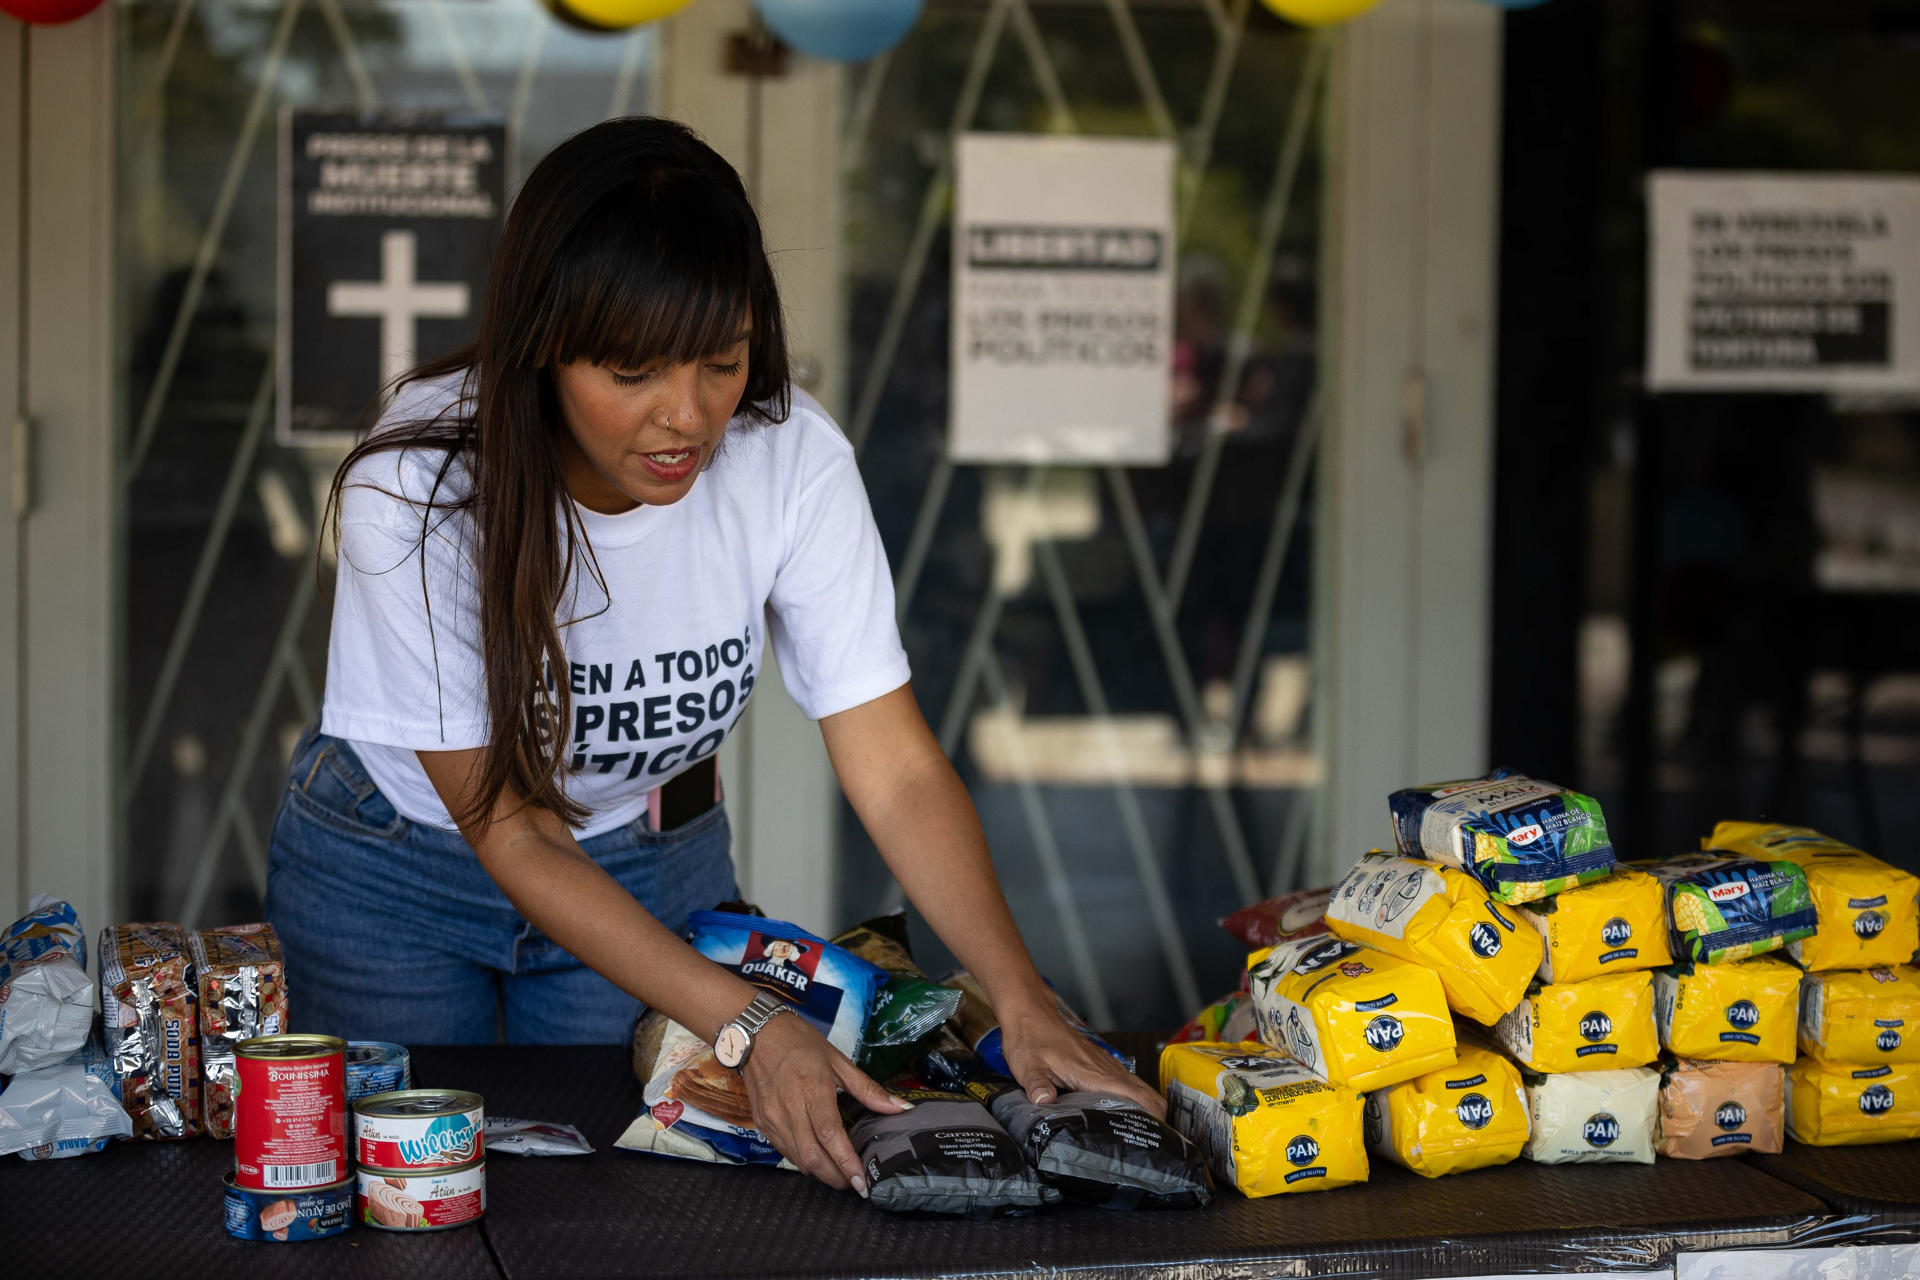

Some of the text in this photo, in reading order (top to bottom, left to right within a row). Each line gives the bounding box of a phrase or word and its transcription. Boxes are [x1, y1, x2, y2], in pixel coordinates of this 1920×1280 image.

[319, 160, 478, 190] MUERTE
[970, 230, 1159, 264] LIBERTAD
[623, 659, 646, 691] A
[574, 663, 755, 743] PRESOS
[1711, 884, 1745, 900] Mary
[1601, 924, 1632, 942] PAN
[1855, 917, 1884, 933] PAN
[1469, 922, 1503, 958] PAN
[741, 962, 810, 992] QUAKER
[1727, 1007, 1759, 1023] PAN
[1365, 1020, 1404, 1045] PAN
[1580, 1019, 1612, 1035] PAN
[165, 1019, 181, 1061] SODA
[1877, 1035, 1901, 1048] PAN
[1264, 1090, 1304, 1103] CONTENIDO
[1859, 1092, 1895, 1110] PAN
[1458, 1100, 1493, 1121] PAN
[1715, 1108, 1746, 1124] PAN
[934, 1131, 995, 1140] Caraota
[1583, 1121, 1619, 1139] PAN
[399, 1119, 482, 1164] Willinger
[1286, 1141, 1319, 1161] PAN
[1307, 1169, 1325, 1177] GLUTEN
